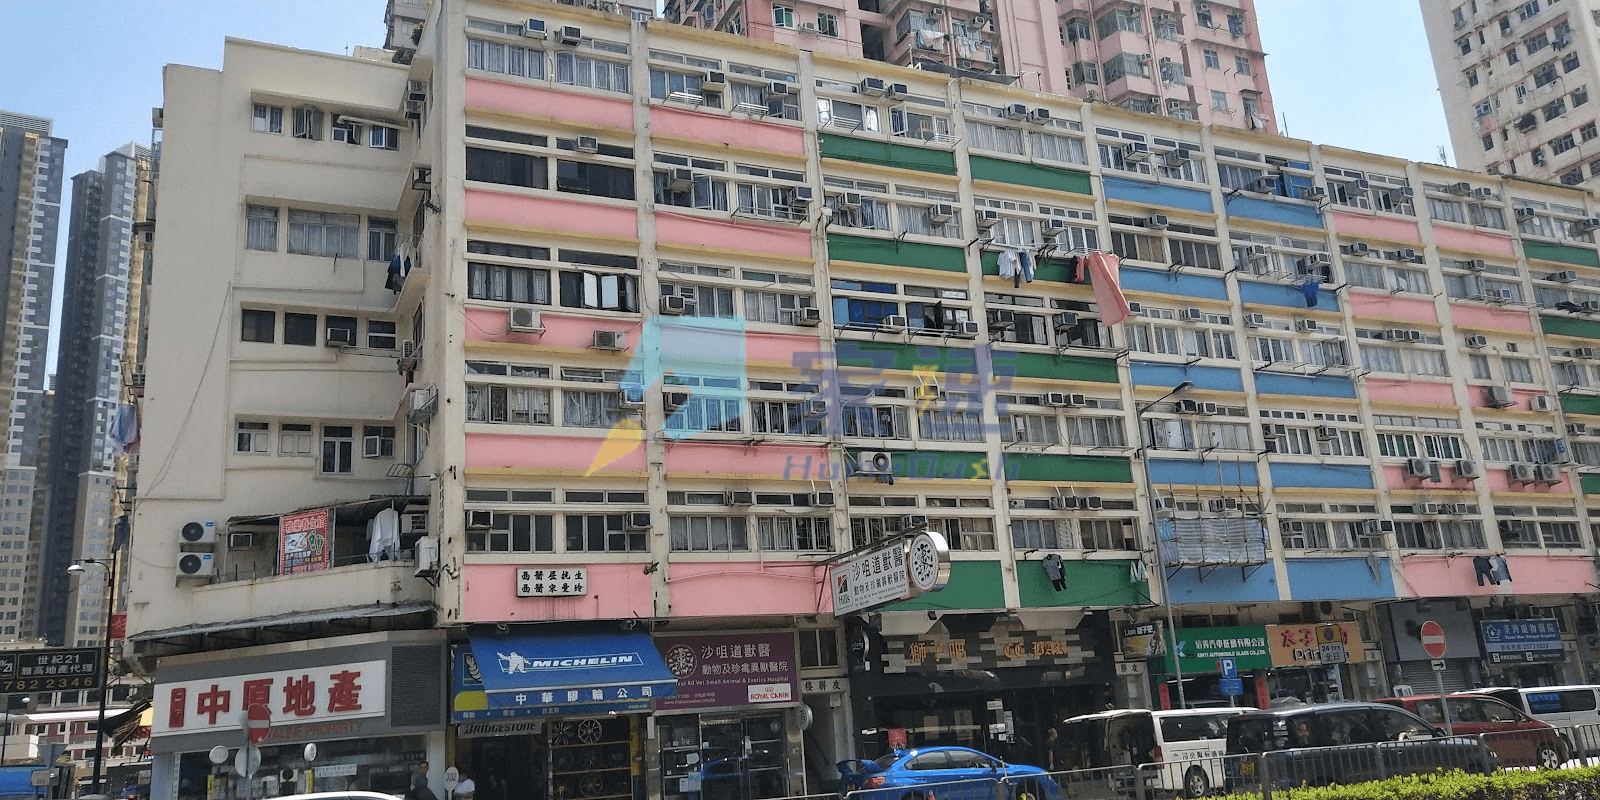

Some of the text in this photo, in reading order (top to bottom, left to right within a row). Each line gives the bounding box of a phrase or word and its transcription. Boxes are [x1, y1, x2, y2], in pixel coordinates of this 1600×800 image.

[852, 546, 903, 582] 沙咀道獸醫
[701, 643, 771, 660] 沙咀道獸醫
[1325, 652, 1339, 661] 全日
[37, 654, 80, 665] 世紀21
[532, 655, 633, 668] MICHELIN
[21, 663, 93, 676] 雅高地產代理
[701, 661, 789, 676] 動物及珍禽異獸醫院
[1222, 659, 1233, 676] P
[45, 676, 93, 689] 2346
[723, 677, 740, 685] Animal
[747, 676, 766, 684] Exotics
[767, 675, 789, 683] Hospital
[197, 670, 362, 725] 中原地產
[515, 686, 653, 706] 中華膠輪公司
[750, 691, 789, 701] ROYAL CANIN
[305, 719, 362, 736] PROPERTY
[463, 722, 537, 735] BRIDGESTONE
